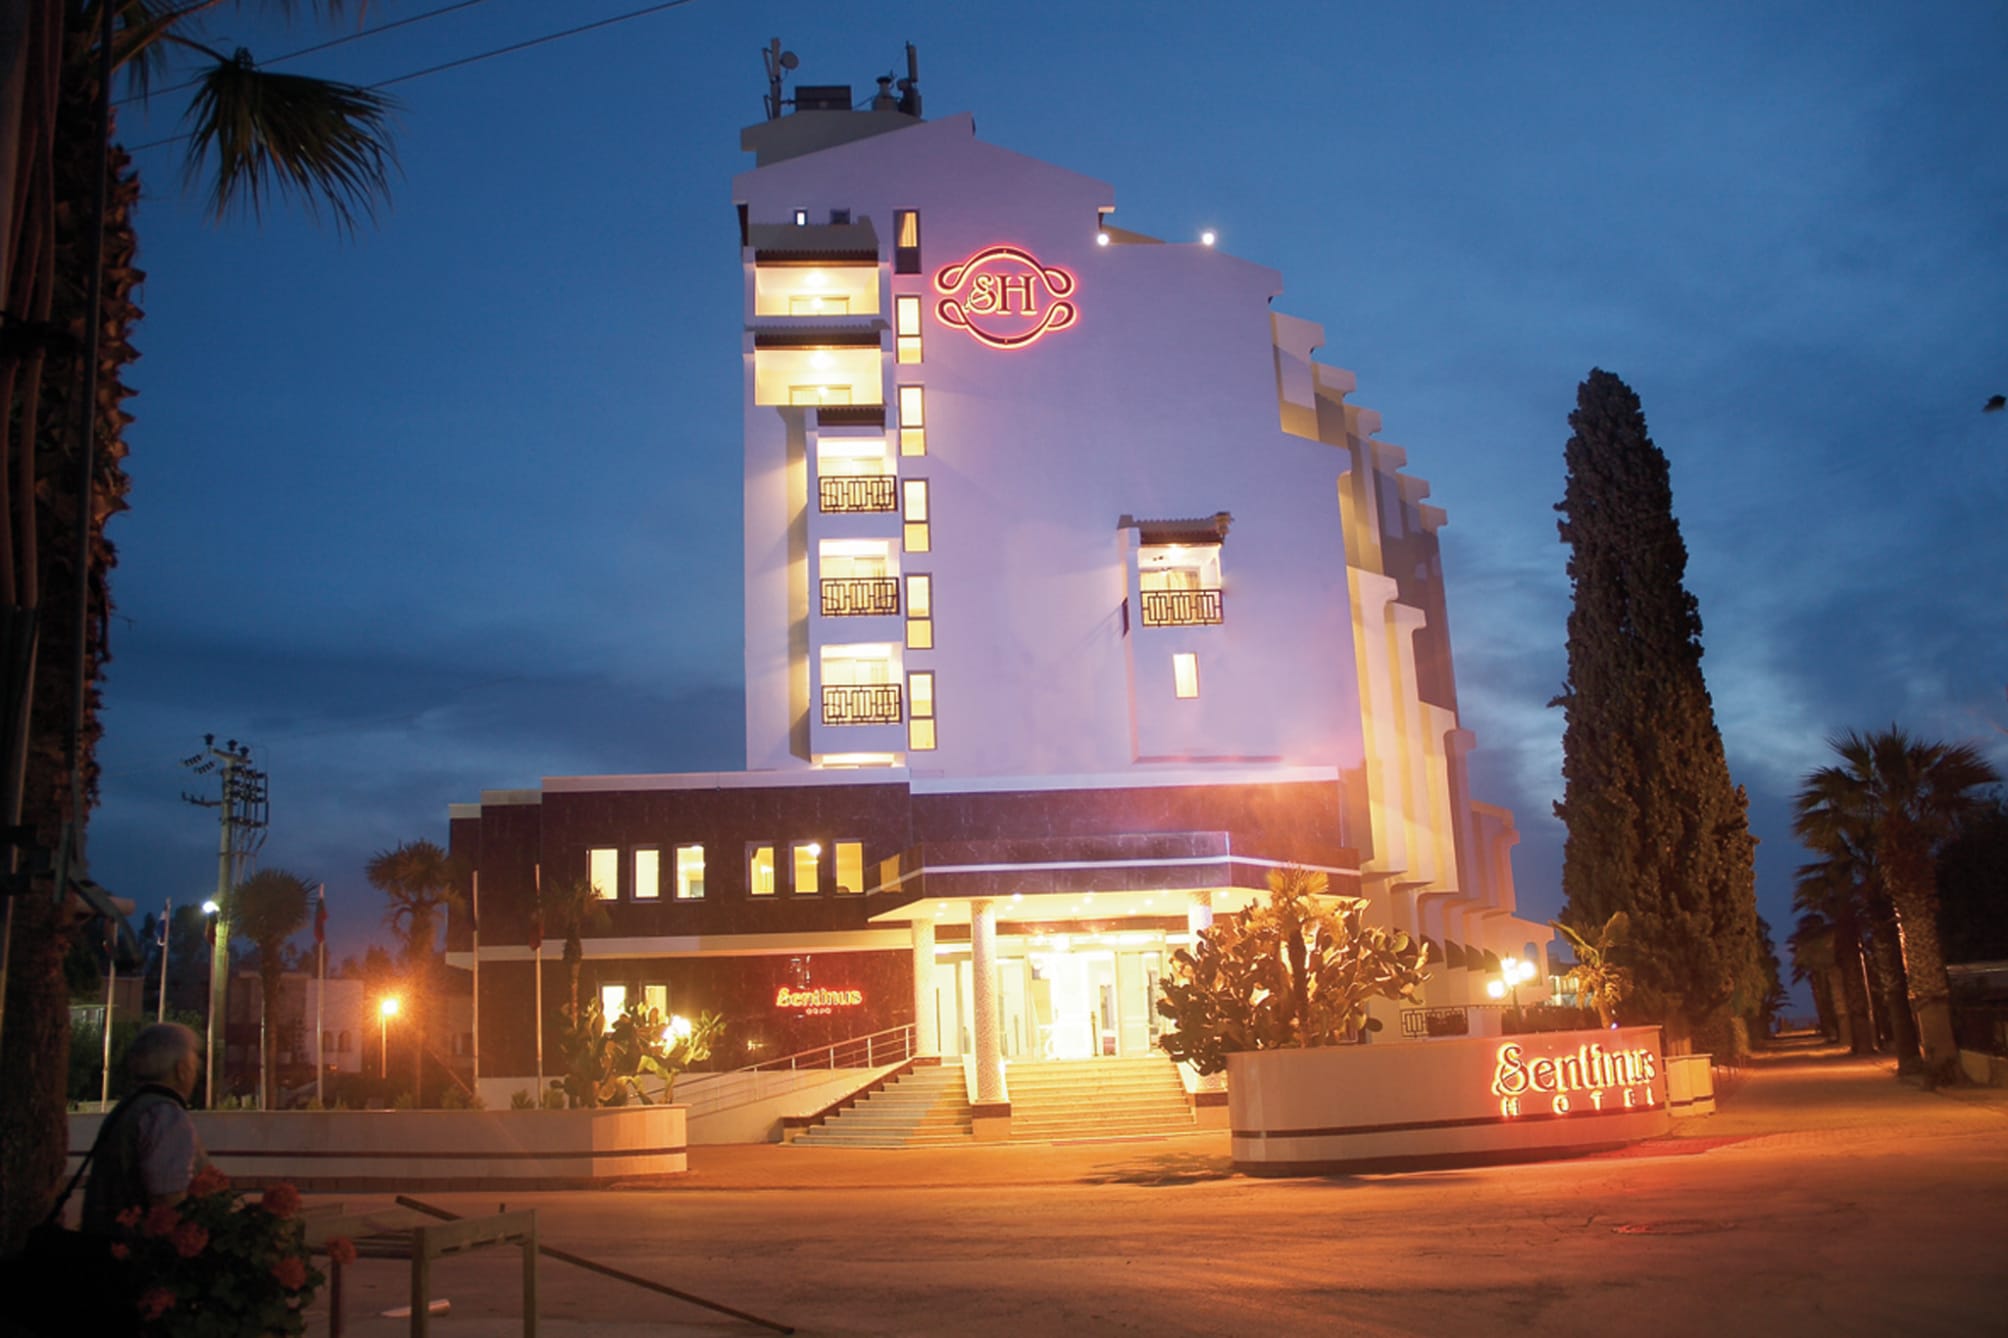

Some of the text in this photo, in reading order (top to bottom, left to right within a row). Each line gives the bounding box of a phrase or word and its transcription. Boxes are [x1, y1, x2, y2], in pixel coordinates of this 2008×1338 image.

[964, 274, 1038, 316] SH
[776, 987, 863, 1008] Sentinus
[1491, 1042, 1656, 1096] Sentinus
[1501, 1087, 1656, 1118] HOTEL
